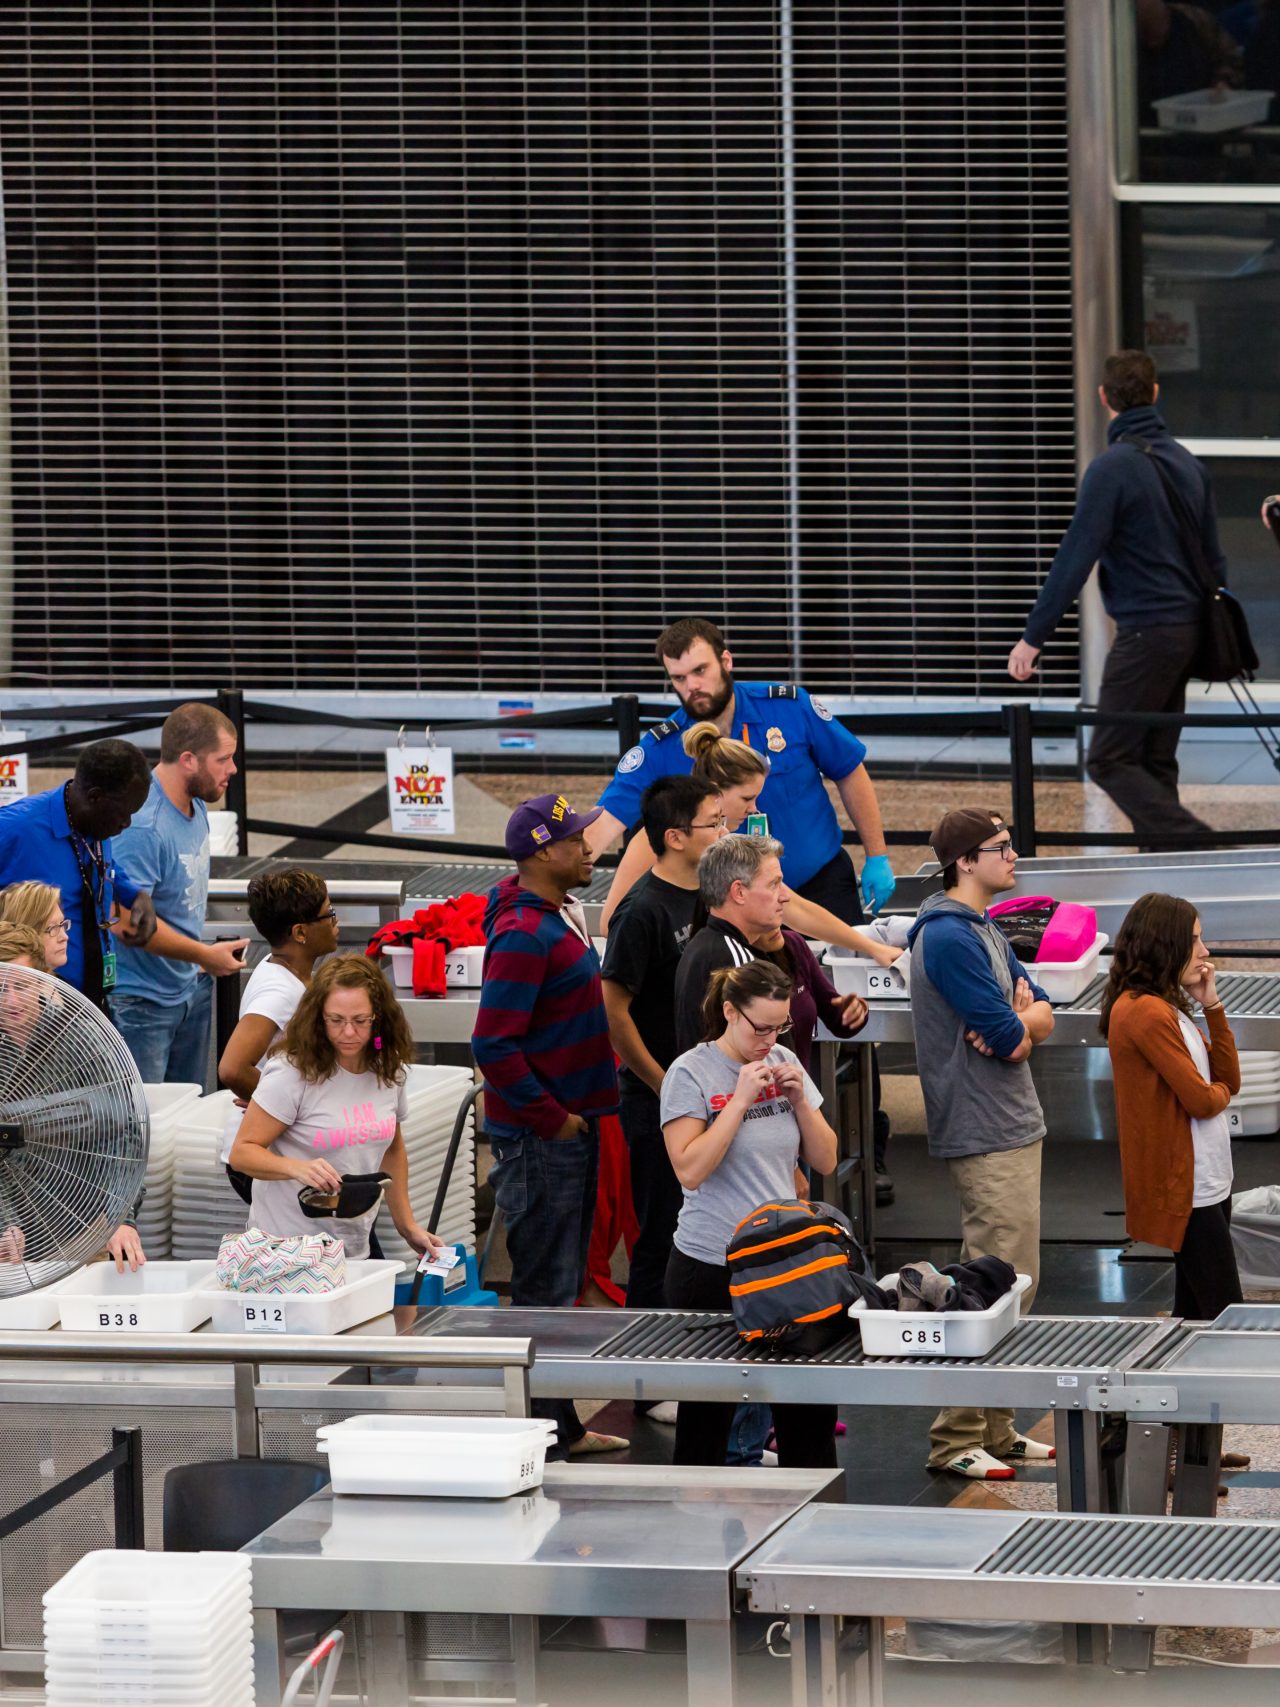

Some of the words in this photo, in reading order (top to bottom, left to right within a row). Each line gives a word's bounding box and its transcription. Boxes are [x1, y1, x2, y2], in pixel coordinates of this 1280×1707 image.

[411, 764, 430, 775] DO
[394, 775, 447, 793] NOT
[400, 795, 444, 805] ENTER
[353, 1101, 378, 1127] AM
